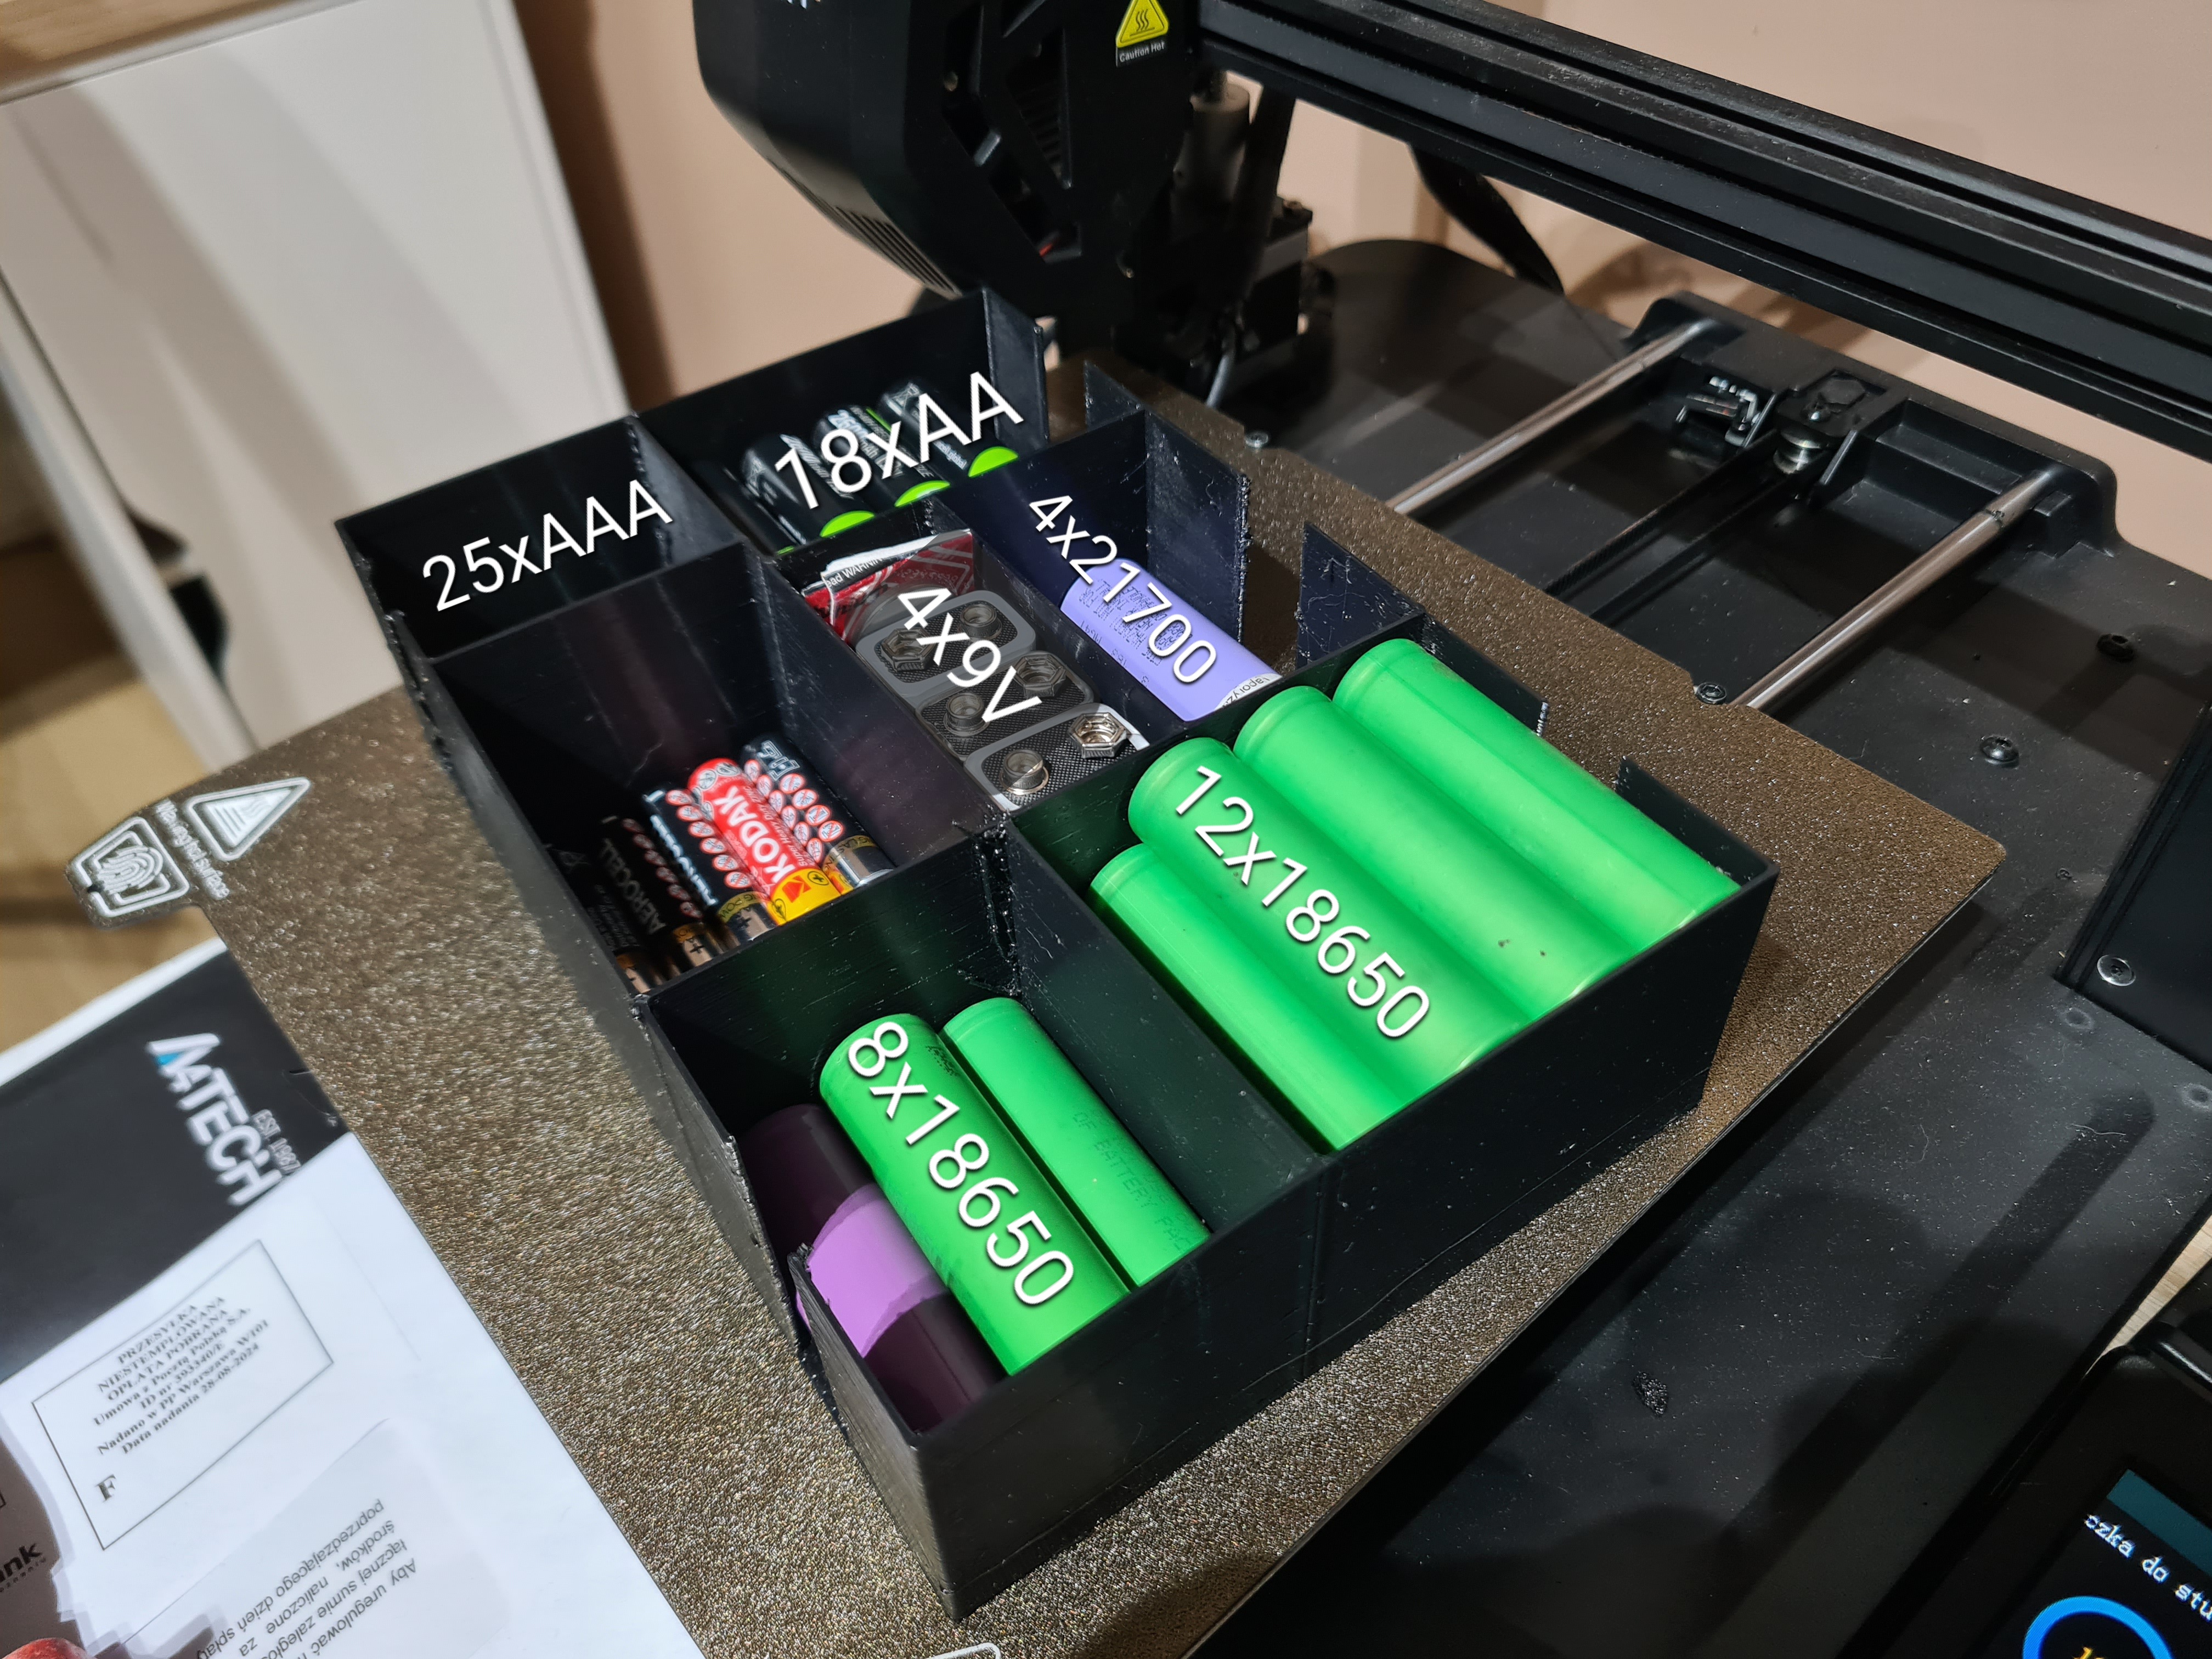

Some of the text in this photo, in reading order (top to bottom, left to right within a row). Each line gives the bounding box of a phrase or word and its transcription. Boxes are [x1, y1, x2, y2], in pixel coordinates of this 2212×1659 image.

[1119, 40, 1166, 63] Caution Hot
[825, 571, 843, 587] ead
[842, 556, 883, 580] WARNIN
[713, 786, 796, 883] KODAK
[770, 821, 791, 844] Heavy
[788, 844, 808, 867] Super
[1154, 1215, 1192, 1253] PAC
[93, 1391, 140, 1426] Umowa
[97, 1418, 146, 1455] Nadano
[158, 1391, 177, 1410] PP
[177, 1347, 237, 1395] Warszawa
[121, 1342, 259, 1455] Data nadania 28-08-2024
[139, 1392, 157, 1410] ID
[95, 1474, 117, 1503] F
[275, 1498, 385, 1598] poprzedzającego
[358, 1538, 408, 1587] łącznej
[2141, 1555, 2170, 1583] do
[238, 1520, 396, 1658] środków, naliczone za
[310, 1558, 417, 1656] Aby uregulować
[317, 1579, 358, 1619] sumie
[236, 1595, 274, 1633] dzień
